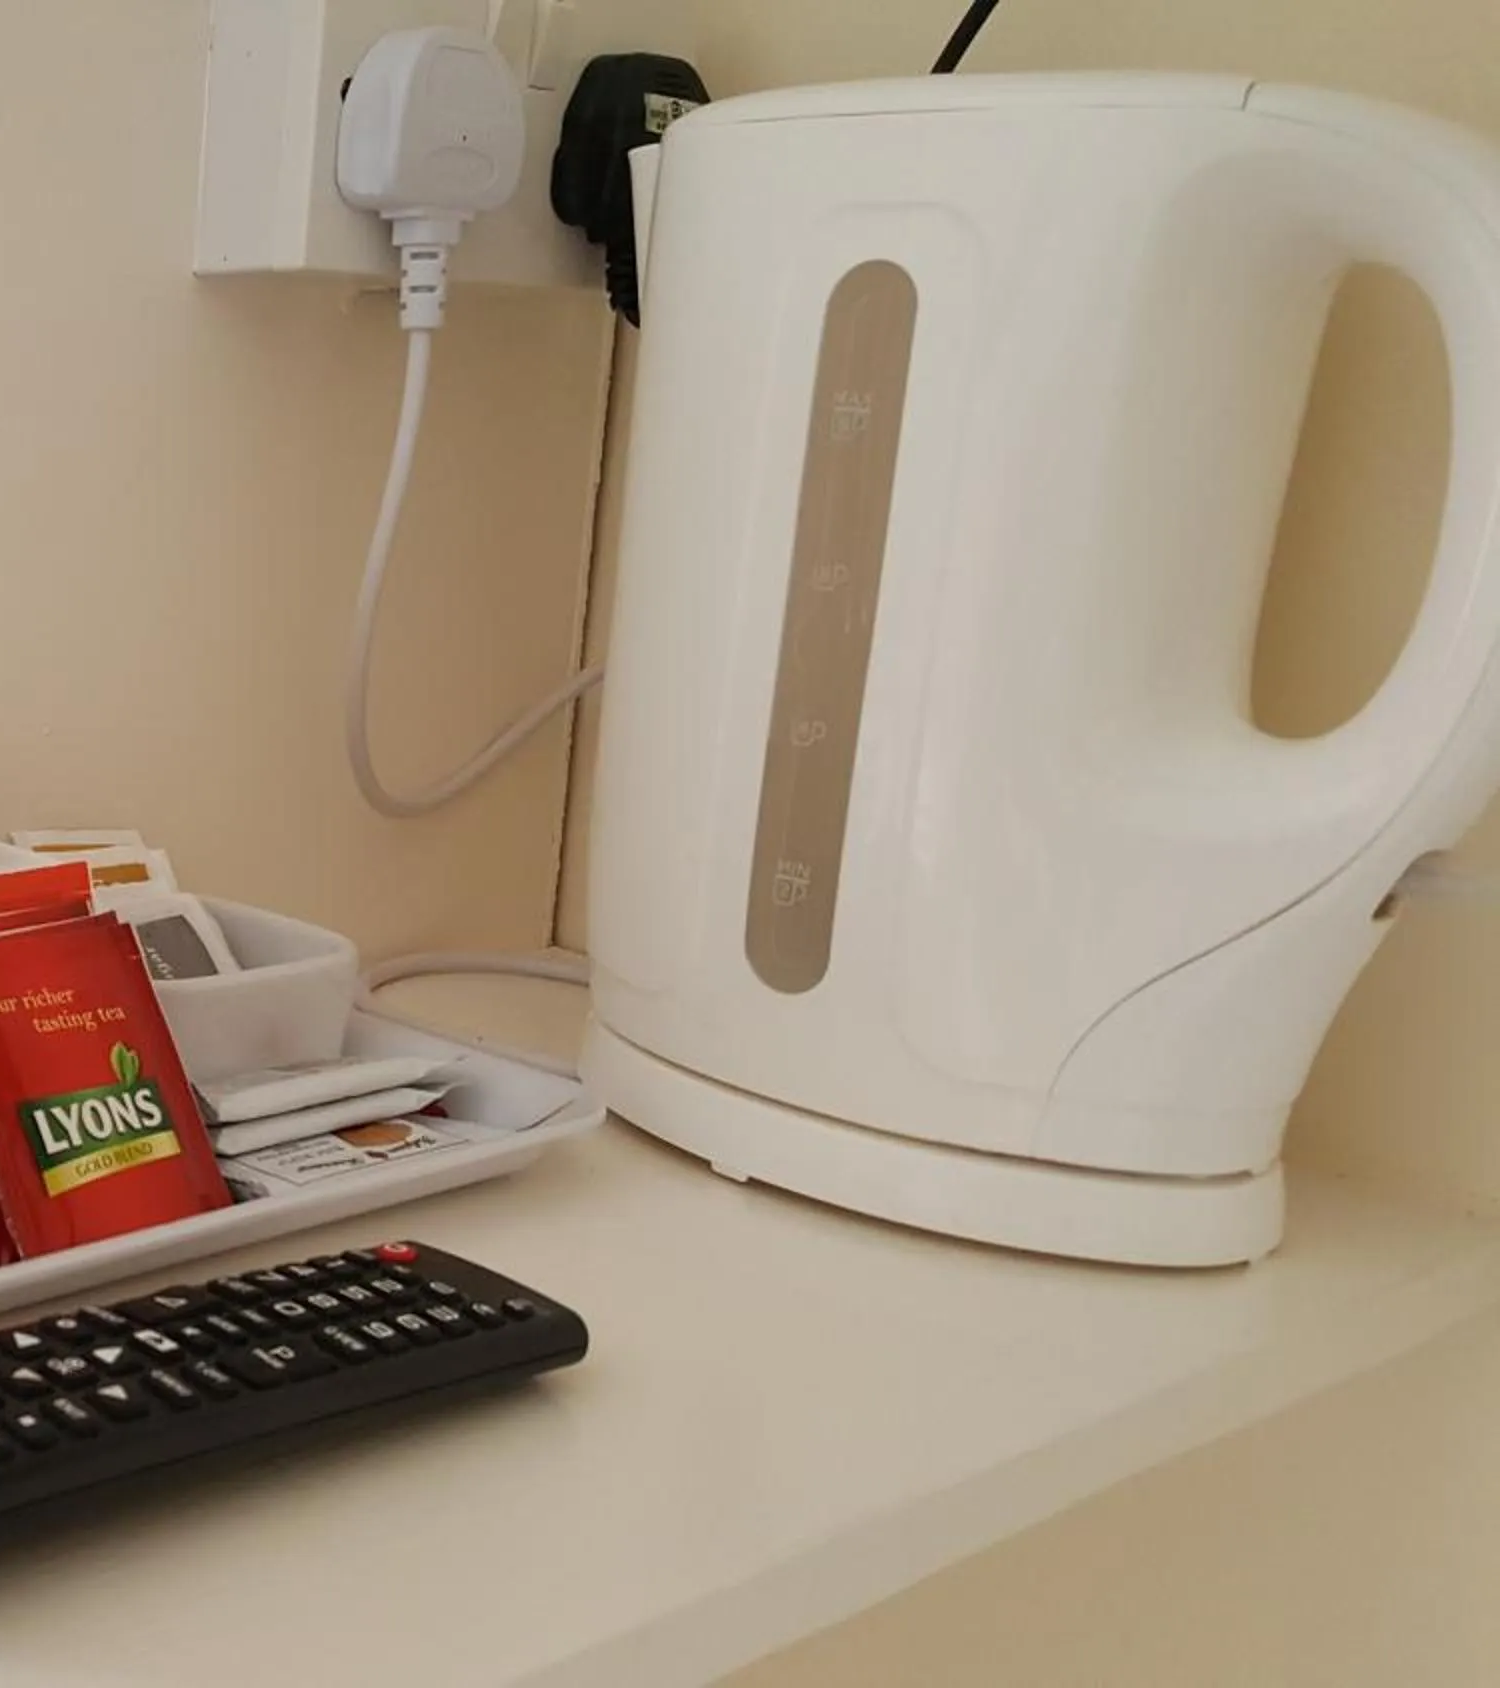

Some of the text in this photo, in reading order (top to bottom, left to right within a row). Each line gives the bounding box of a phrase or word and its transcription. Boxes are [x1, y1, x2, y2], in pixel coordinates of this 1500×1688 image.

[777, 857, 811, 877] MIN
[22, 987, 74, 1009] richer
[33, 1006, 126, 1034] tasting tea
[33, 1087, 163, 1156] LYONS
[75, 1141, 153, 1177] GOLD BLEND
